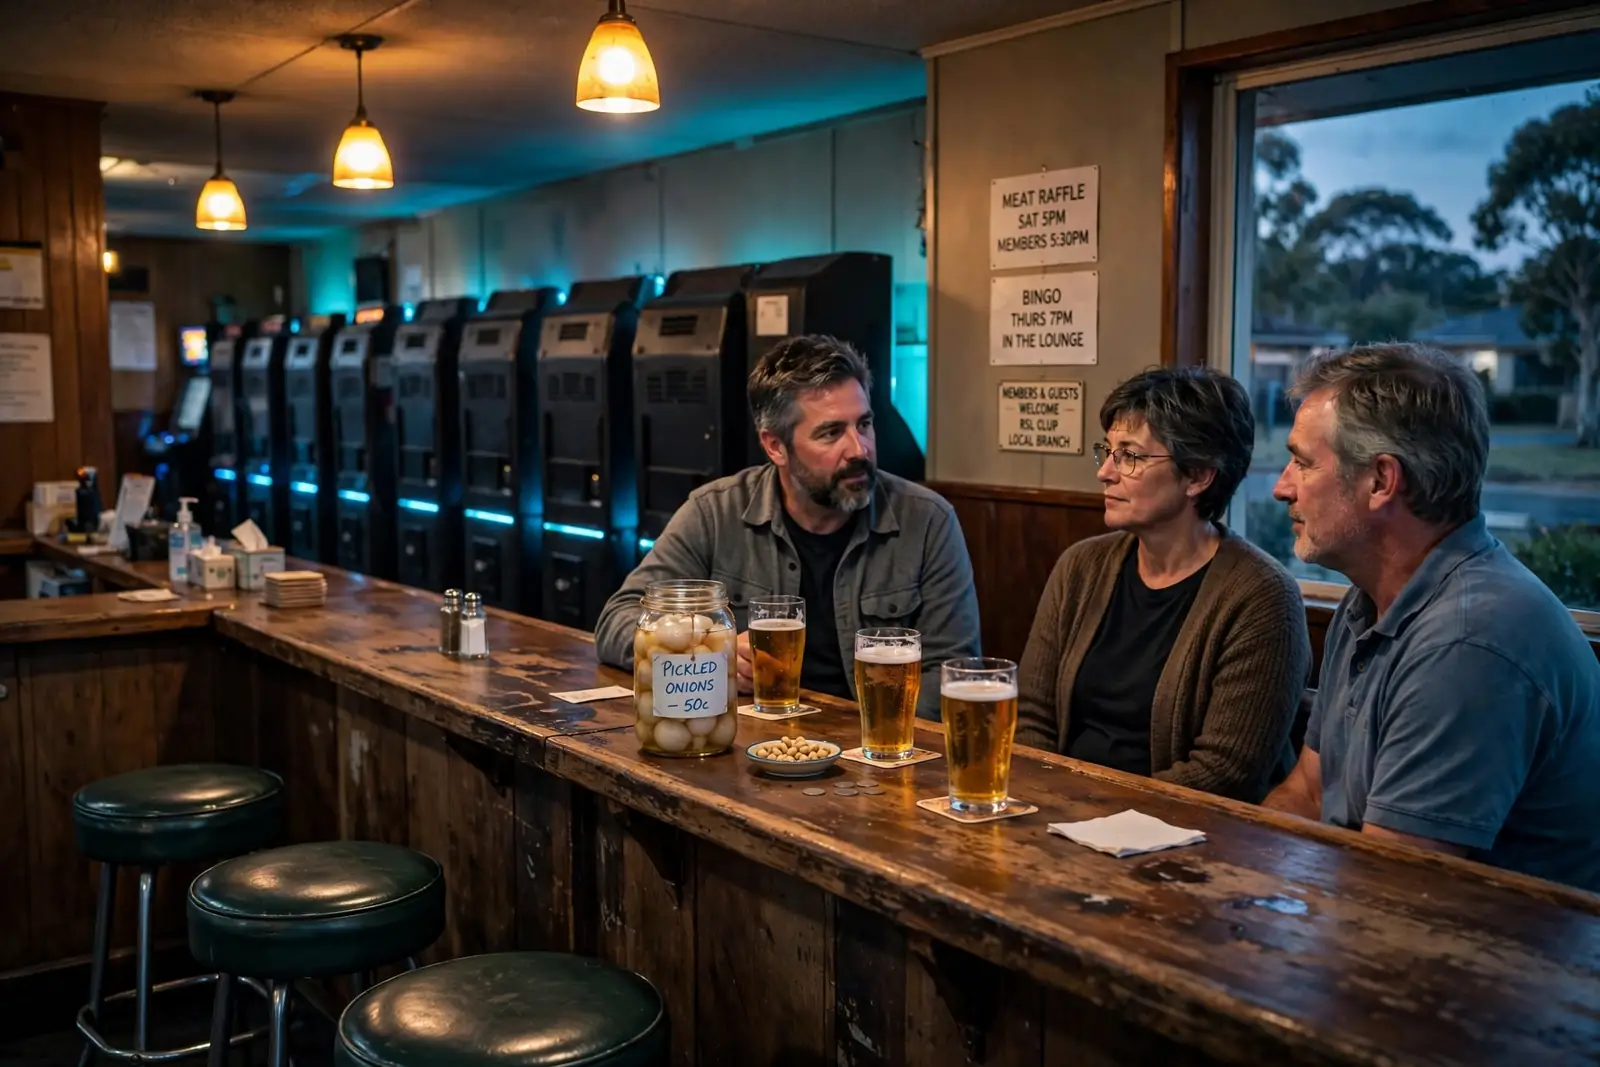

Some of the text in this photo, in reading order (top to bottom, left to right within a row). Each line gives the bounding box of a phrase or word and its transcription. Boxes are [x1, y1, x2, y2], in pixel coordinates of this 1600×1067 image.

[1002, 183, 1085, 209] MEAT RAFFLE
[1018, 209, 1066, 230] SAT 5PM
[1050, 230, 1089, 247] 5:30PM
[1022, 288, 1062, 306] BINGO
[1011, 310, 1073, 327] THURS 7PM
[1002, 332, 1085, 349] IN THE LOUNGE
[1048, 387, 1079, 400] GUESTS
[1019, 402, 1059, 415] WELCOME
[1008, 433, 1070, 448] LOCAL BRANCH
[662, 660, 717, 677] PICKLED
[665, 678, 714, 694] ONIONS
